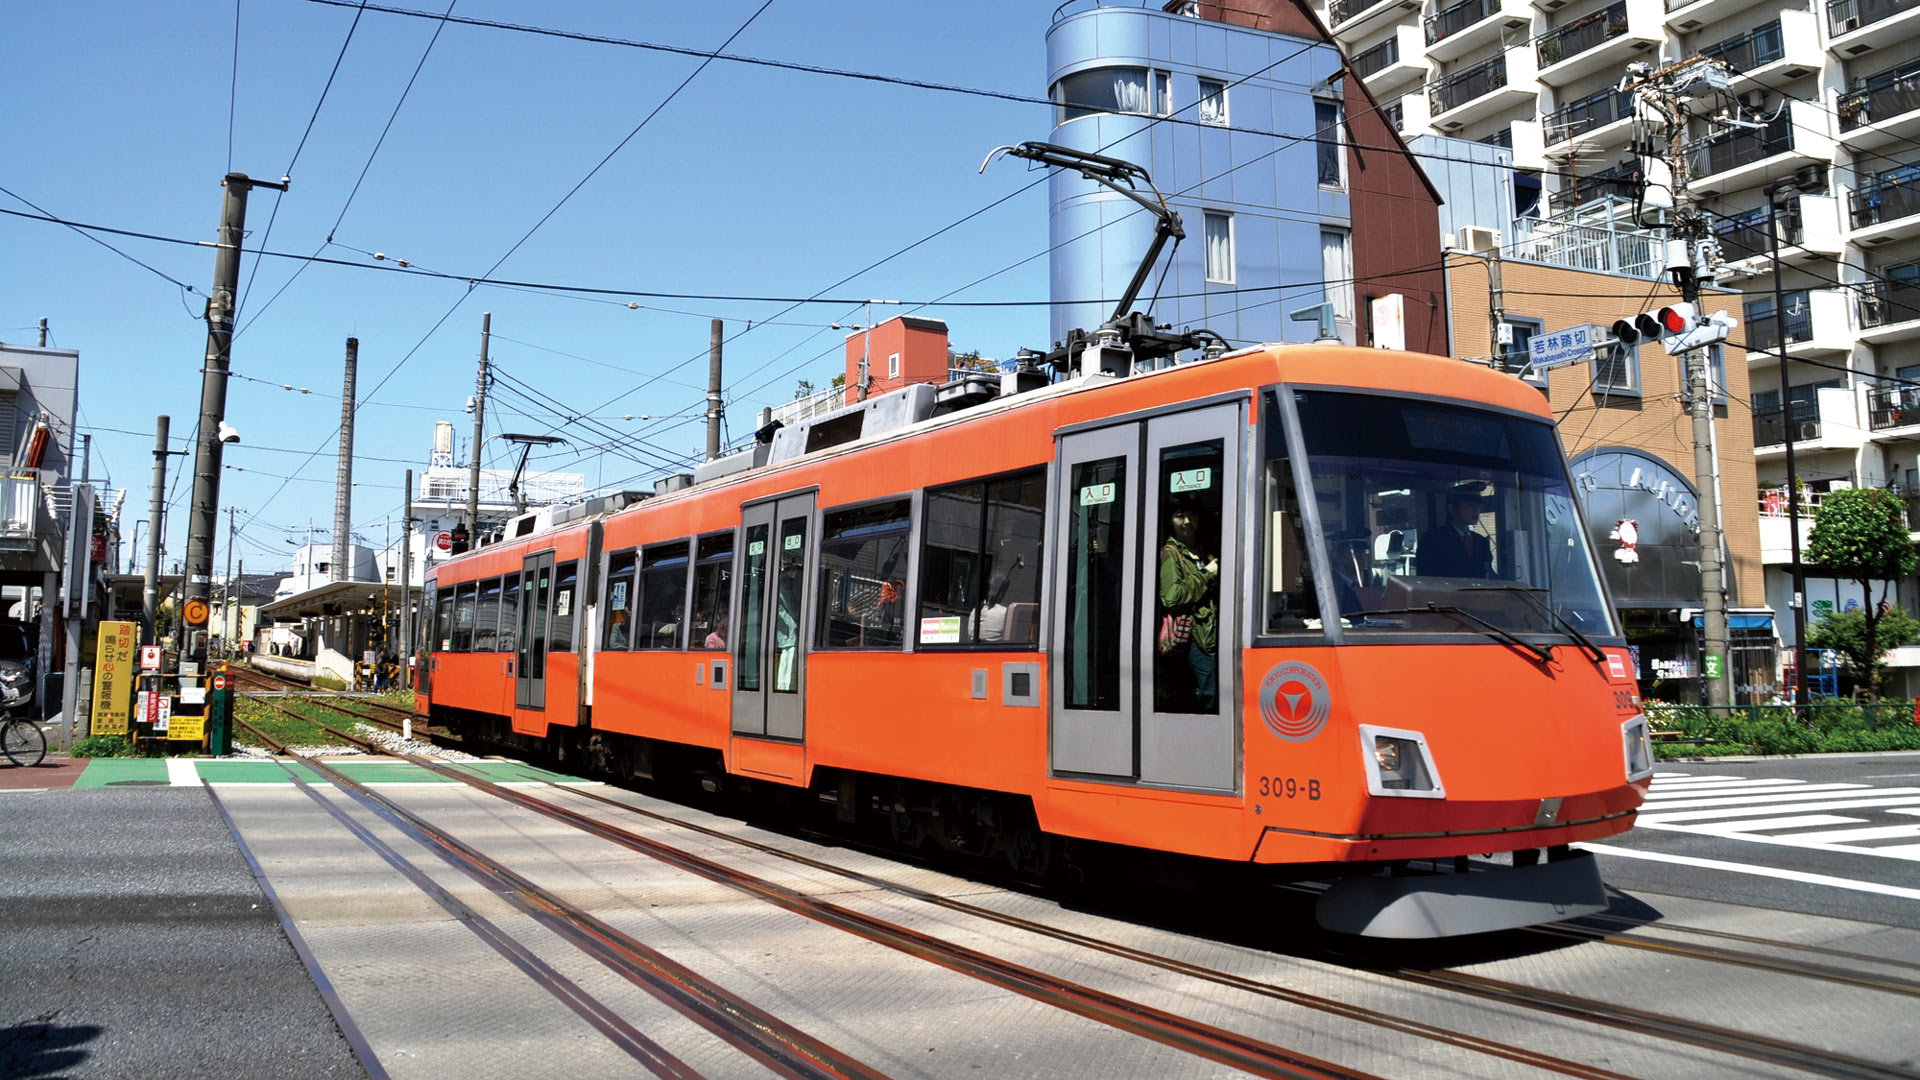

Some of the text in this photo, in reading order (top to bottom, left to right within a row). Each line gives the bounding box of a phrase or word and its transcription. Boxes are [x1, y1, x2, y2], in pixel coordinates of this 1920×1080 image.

[1534, 330, 1586, 354] 若林踏切
[1532, 346, 1592, 364] Wakabayashi Crossing
[1176, 470, 1205, 485] 入口
[1085, 485, 1110, 499] 入口
[190, 606, 203, 619] C
[117, 624, 131, 662] 踏切だ
[101, 634, 116, 710] 鳴らせ心の警報機
[1706, 661, 1718, 674] 文
[1260, 776, 1321, 801] 309-B
